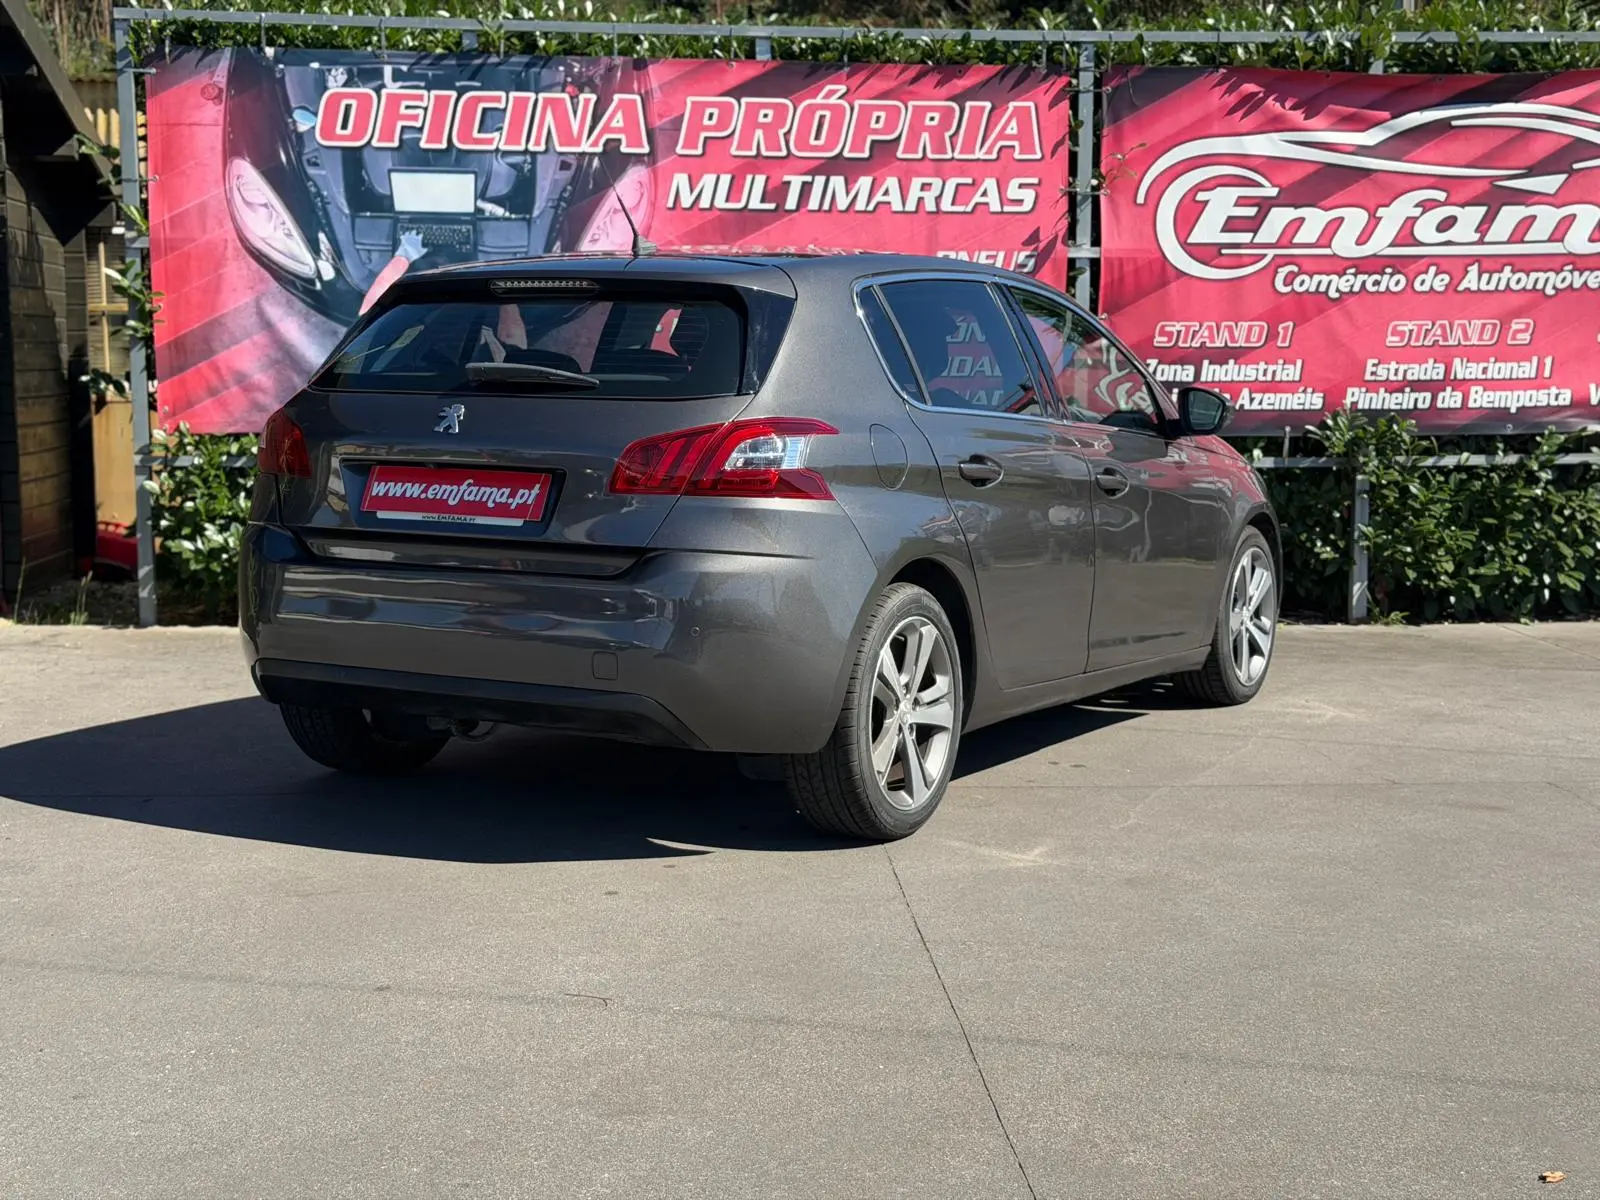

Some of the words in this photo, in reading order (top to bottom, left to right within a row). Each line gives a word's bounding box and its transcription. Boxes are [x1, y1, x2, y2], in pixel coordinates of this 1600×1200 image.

[315, 88, 650, 154] OFICINA
[675, 84, 1043, 160] PRÓPRIA
[666, 173, 1040, 213] MULTIMARCAS
[1186, 186, 1600, 259] Emfam
[1274, 265, 1407, 299] Comércio
[1413, 266, 1450, 292] de
[1457, 262, 1600, 296] Automóve
[1154, 321, 1268, 347] STAND
[1276, 321, 1294, 347] 1
[1385, 319, 1501, 347] STAND
[1507, 318, 1534, 345] 2
[1200, 358, 1303, 382] Industrial
[1364, 358, 1446, 381] Estrada
[1450, 355, 1540, 380] Nacional
[1543, 355, 1554, 379] 1
[1235, 387, 1325, 410] Azeméis
[1345, 386, 1432, 411] Pinheiro
[1436, 386, 1463, 409] da
[1468, 385, 1572, 413] Bemposta
[371, 479, 541, 509] www.emfama.pt
